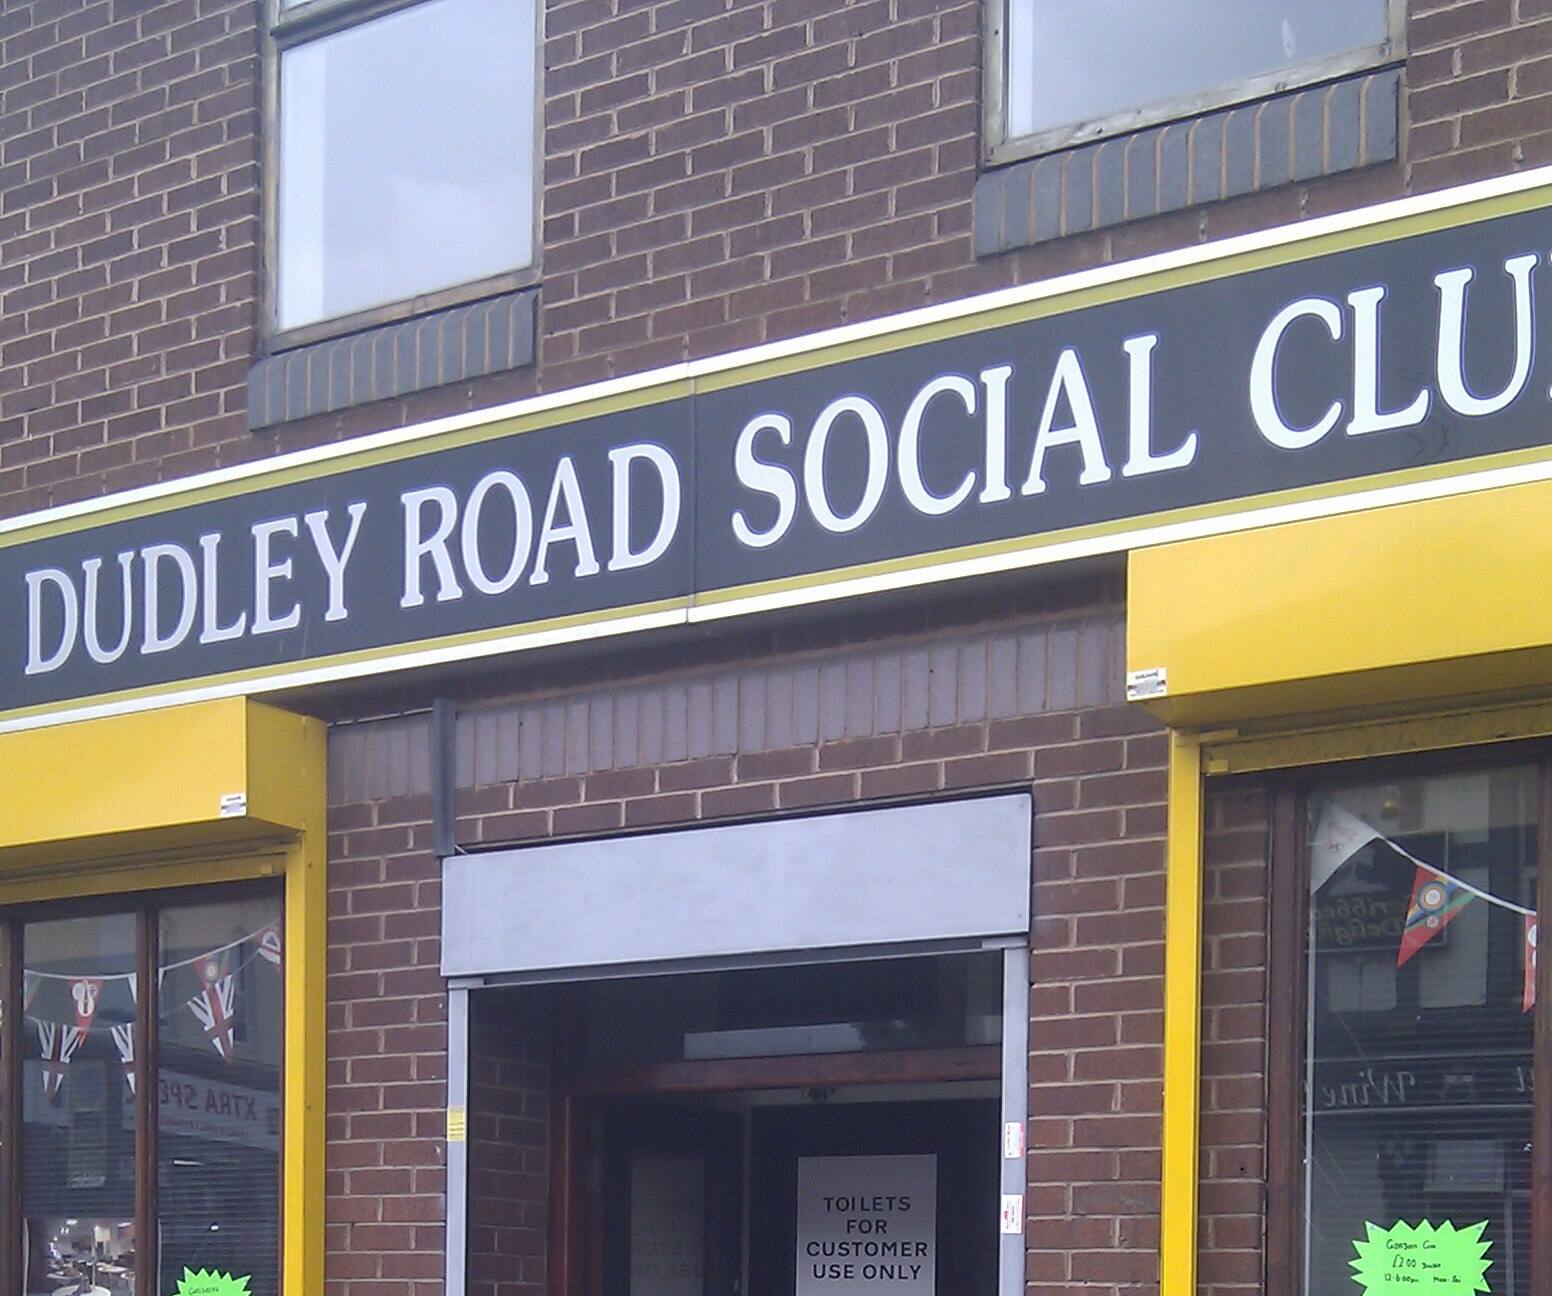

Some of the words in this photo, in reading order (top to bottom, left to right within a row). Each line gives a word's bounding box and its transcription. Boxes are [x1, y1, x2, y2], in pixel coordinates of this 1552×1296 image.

[25, 502, 367, 675] DUDLEY
[400, 443, 680, 608] ROAD
[731, 334, 1198, 548] SOCIAL
[1250, 252, 1552, 449] CLU
[823, 1196, 911, 1212] TOILETS
[846, 1219, 888, 1234] FOR
[806, 1241, 928, 1257] CUSTOMER
[813, 1264, 854, 1279] USE
[862, 1264, 922, 1280] ONLY
